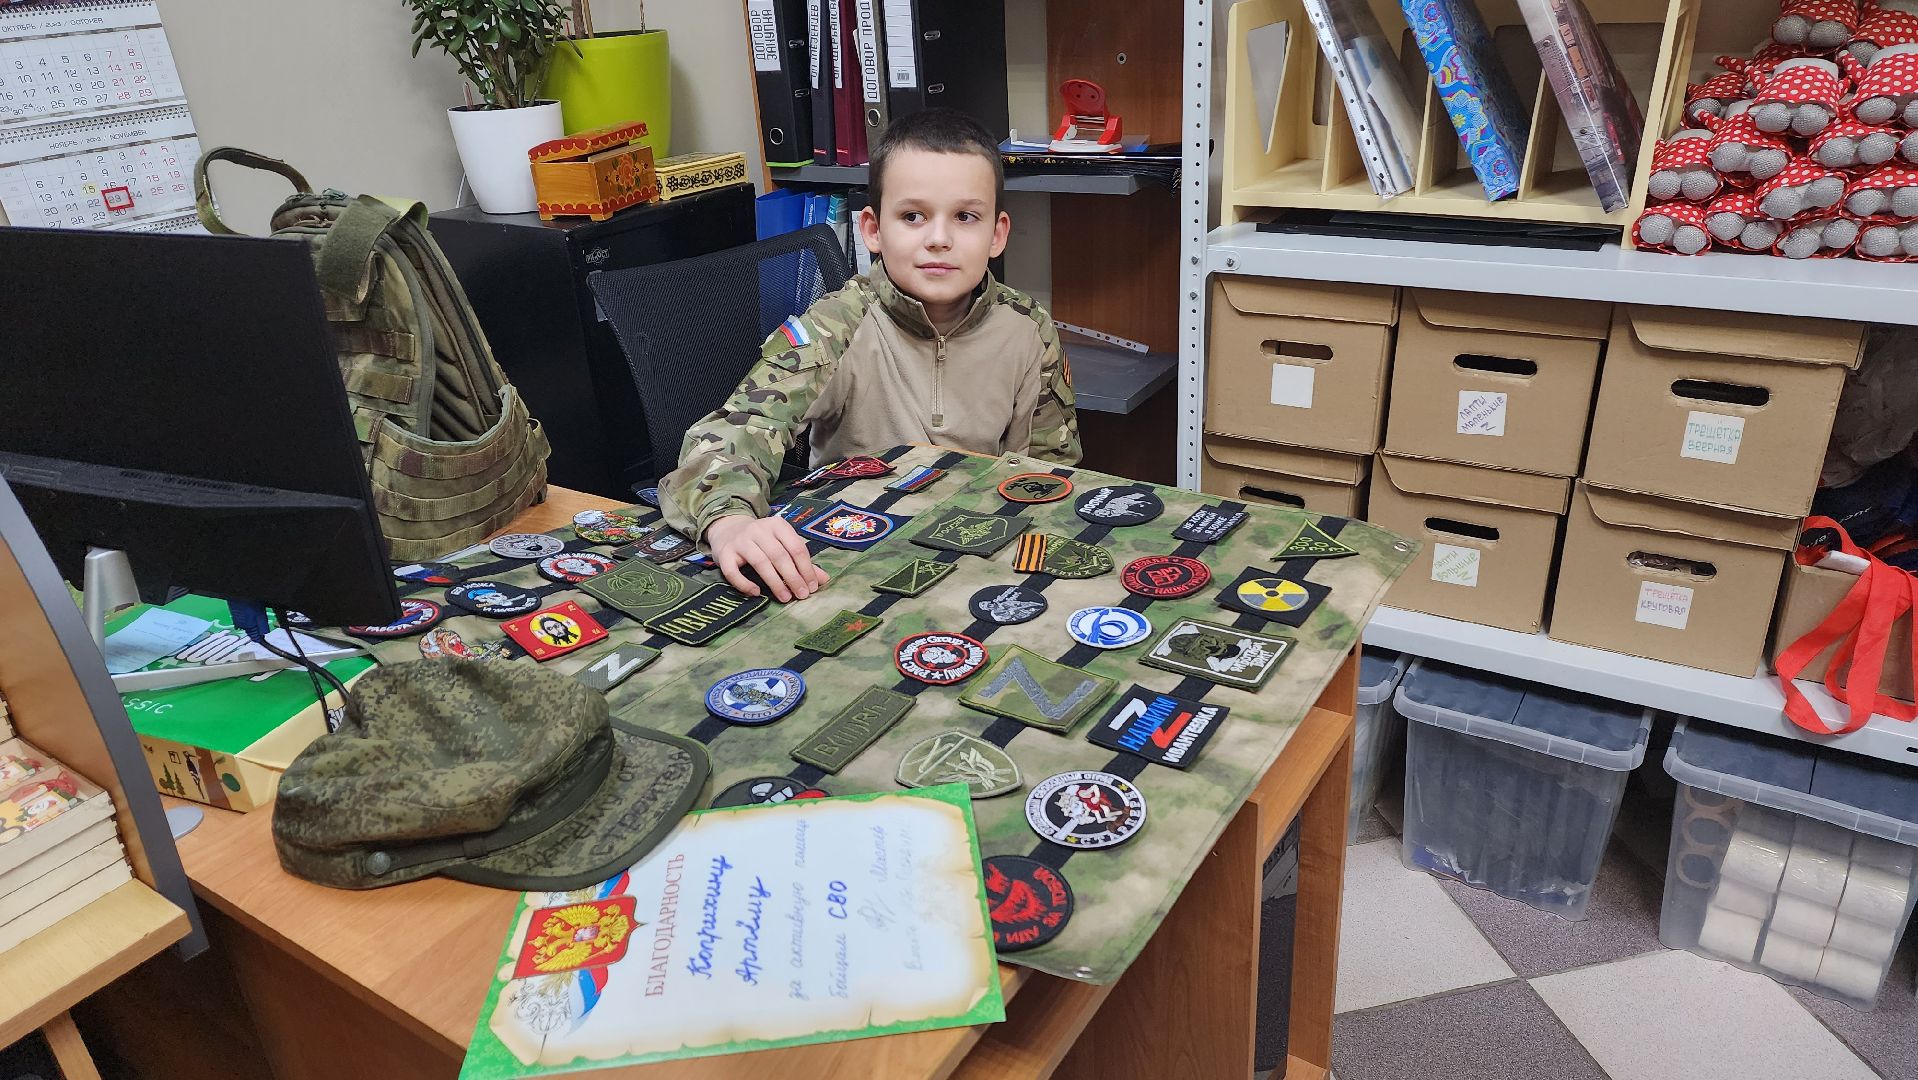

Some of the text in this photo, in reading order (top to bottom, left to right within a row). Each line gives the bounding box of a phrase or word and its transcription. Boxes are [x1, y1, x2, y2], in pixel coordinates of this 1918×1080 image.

[751, 9, 765, 60] ДОГОВОР
[761, 9, 777, 61] ЗАКУПКА
[864, 42, 878, 100] ДОГОВОР
[110, 130, 147, 141] NOVEMBER
[1289, 536, 1313, 552] 300
[659, 609, 718, 635] ЧВК
[926, 635, 963, 647] Group
[588, 652, 644, 682] Z
[122, 696, 173, 714] SSIC
[1162, 706, 1219, 763] ИВАНТЕЕВКА
[828, 880, 848, 920] СВО
[645, 853, 685, 997] БЛАГОДАРНОСТЬ
[735, 876, 771, 985] Артёму
[785, 882, 811, 969] активную
[789, 980, 810, 1000] за
